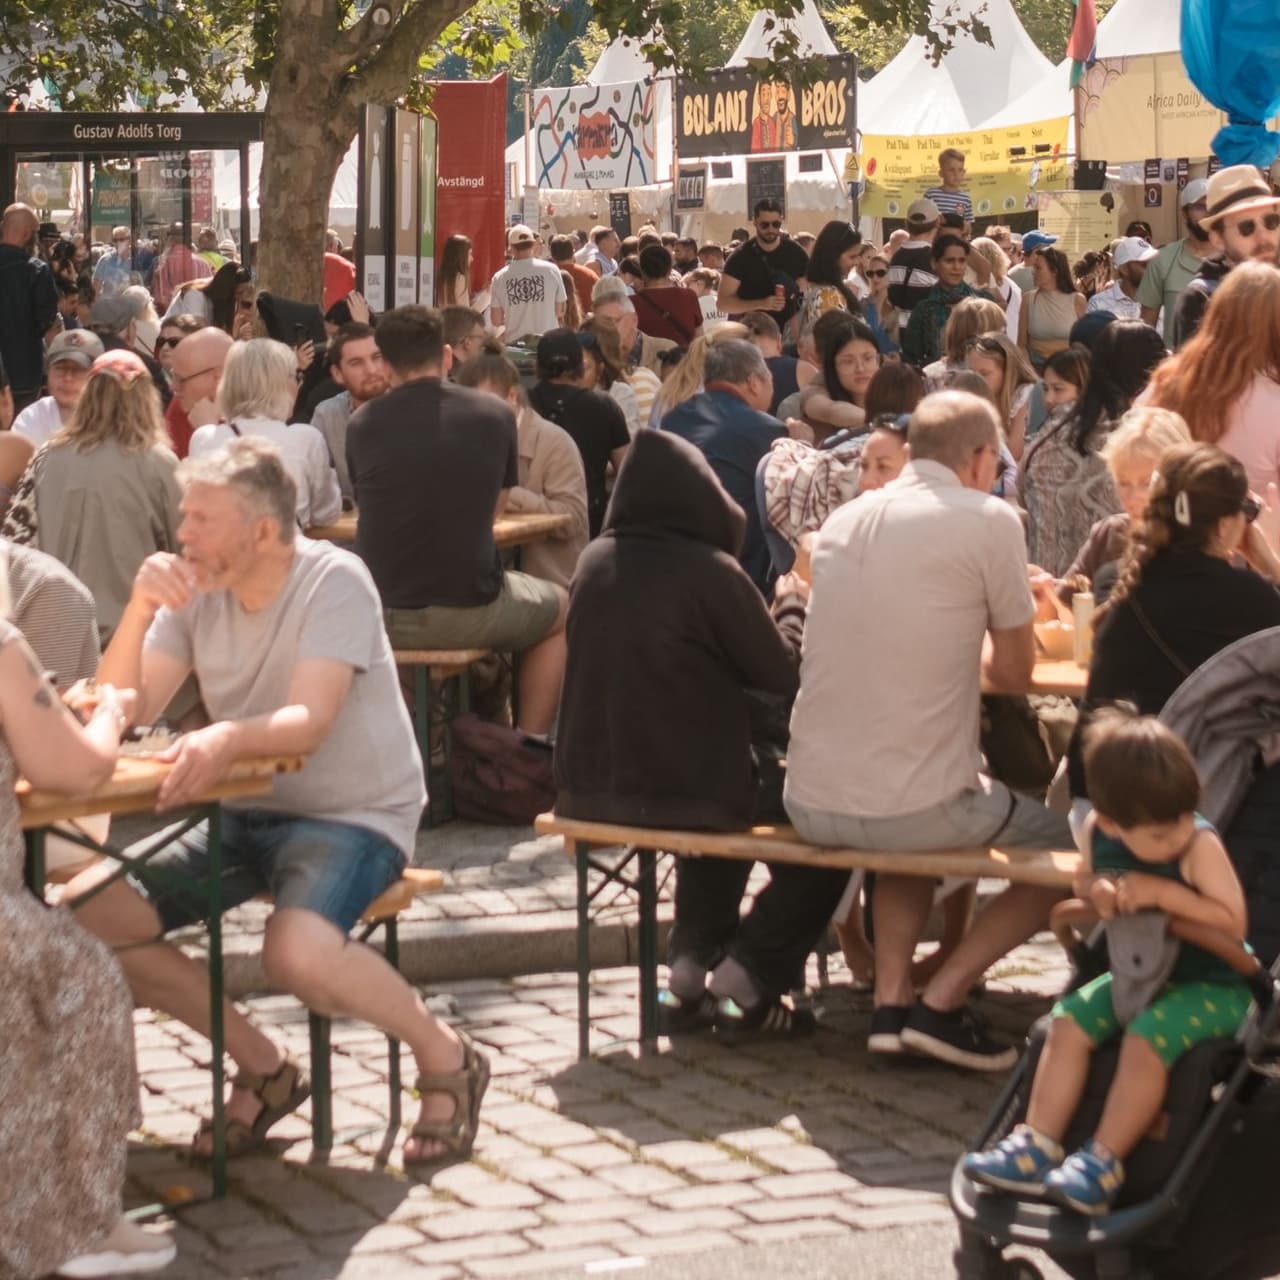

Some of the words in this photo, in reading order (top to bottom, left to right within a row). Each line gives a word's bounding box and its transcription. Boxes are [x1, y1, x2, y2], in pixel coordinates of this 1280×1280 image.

[683, 89, 748, 136] BOLANI
[801, 77, 847, 127] BROS
[73, 124, 114, 139] Gustav
[117, 124, 153, 139] Adolfs
[157, 124, 182, 141] Torg
[436, 175, 485, 188] Avstängd
